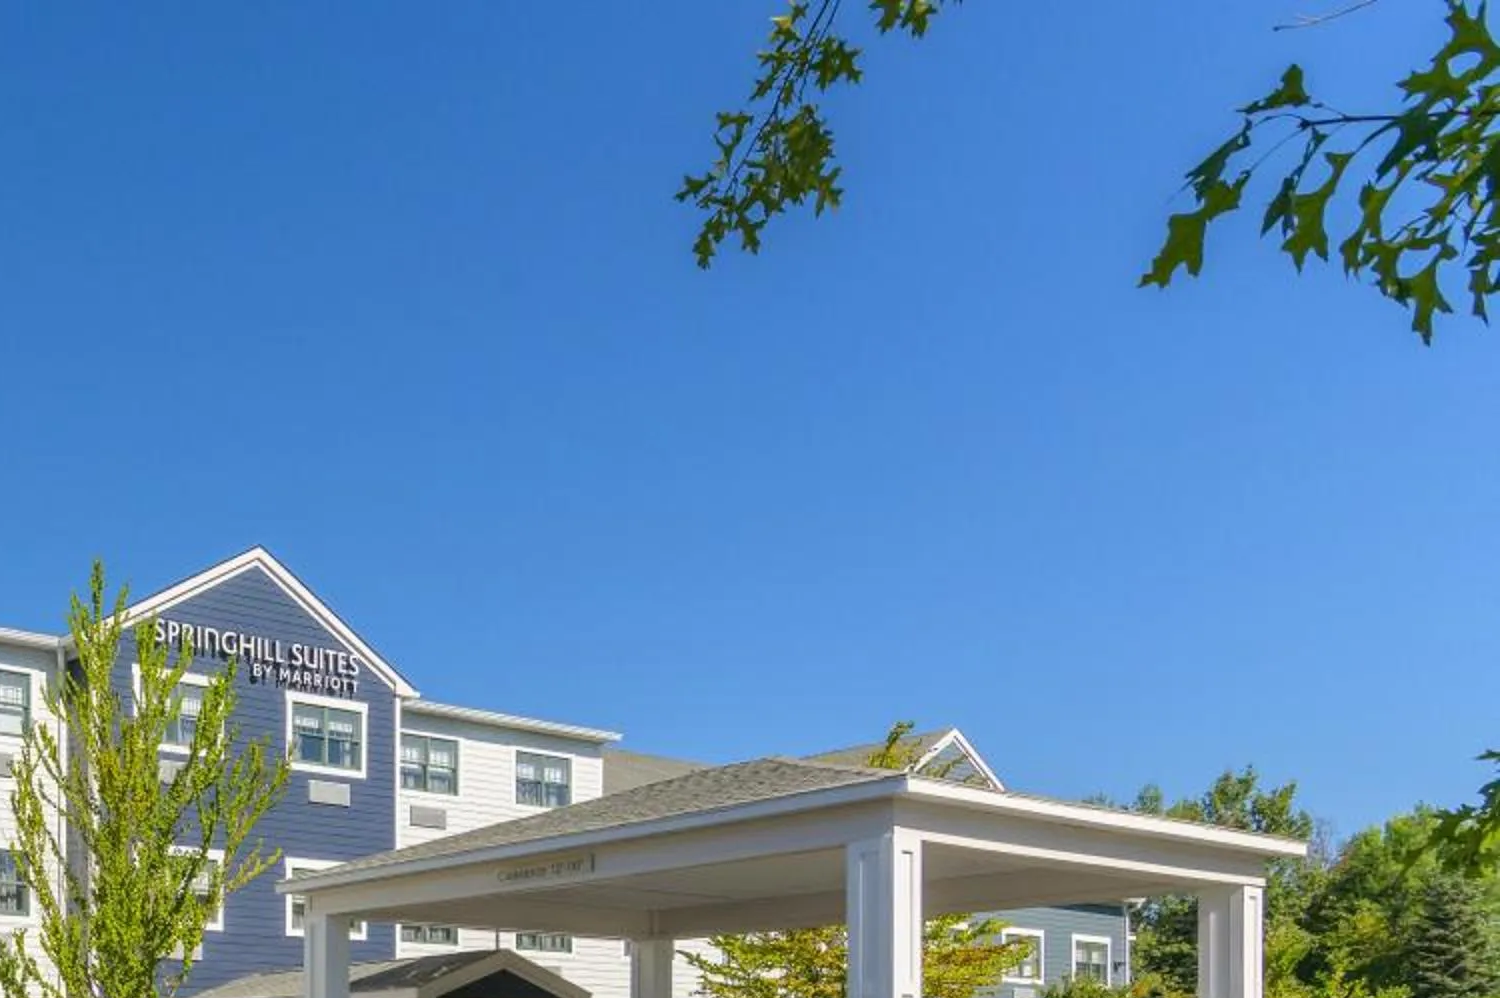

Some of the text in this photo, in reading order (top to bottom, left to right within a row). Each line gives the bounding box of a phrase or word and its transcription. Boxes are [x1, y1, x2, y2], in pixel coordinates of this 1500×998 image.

[155, 618, 360, 676] SPRINGHILL SUITES
[253, 663, 359, 693] BY MARRIOTT
